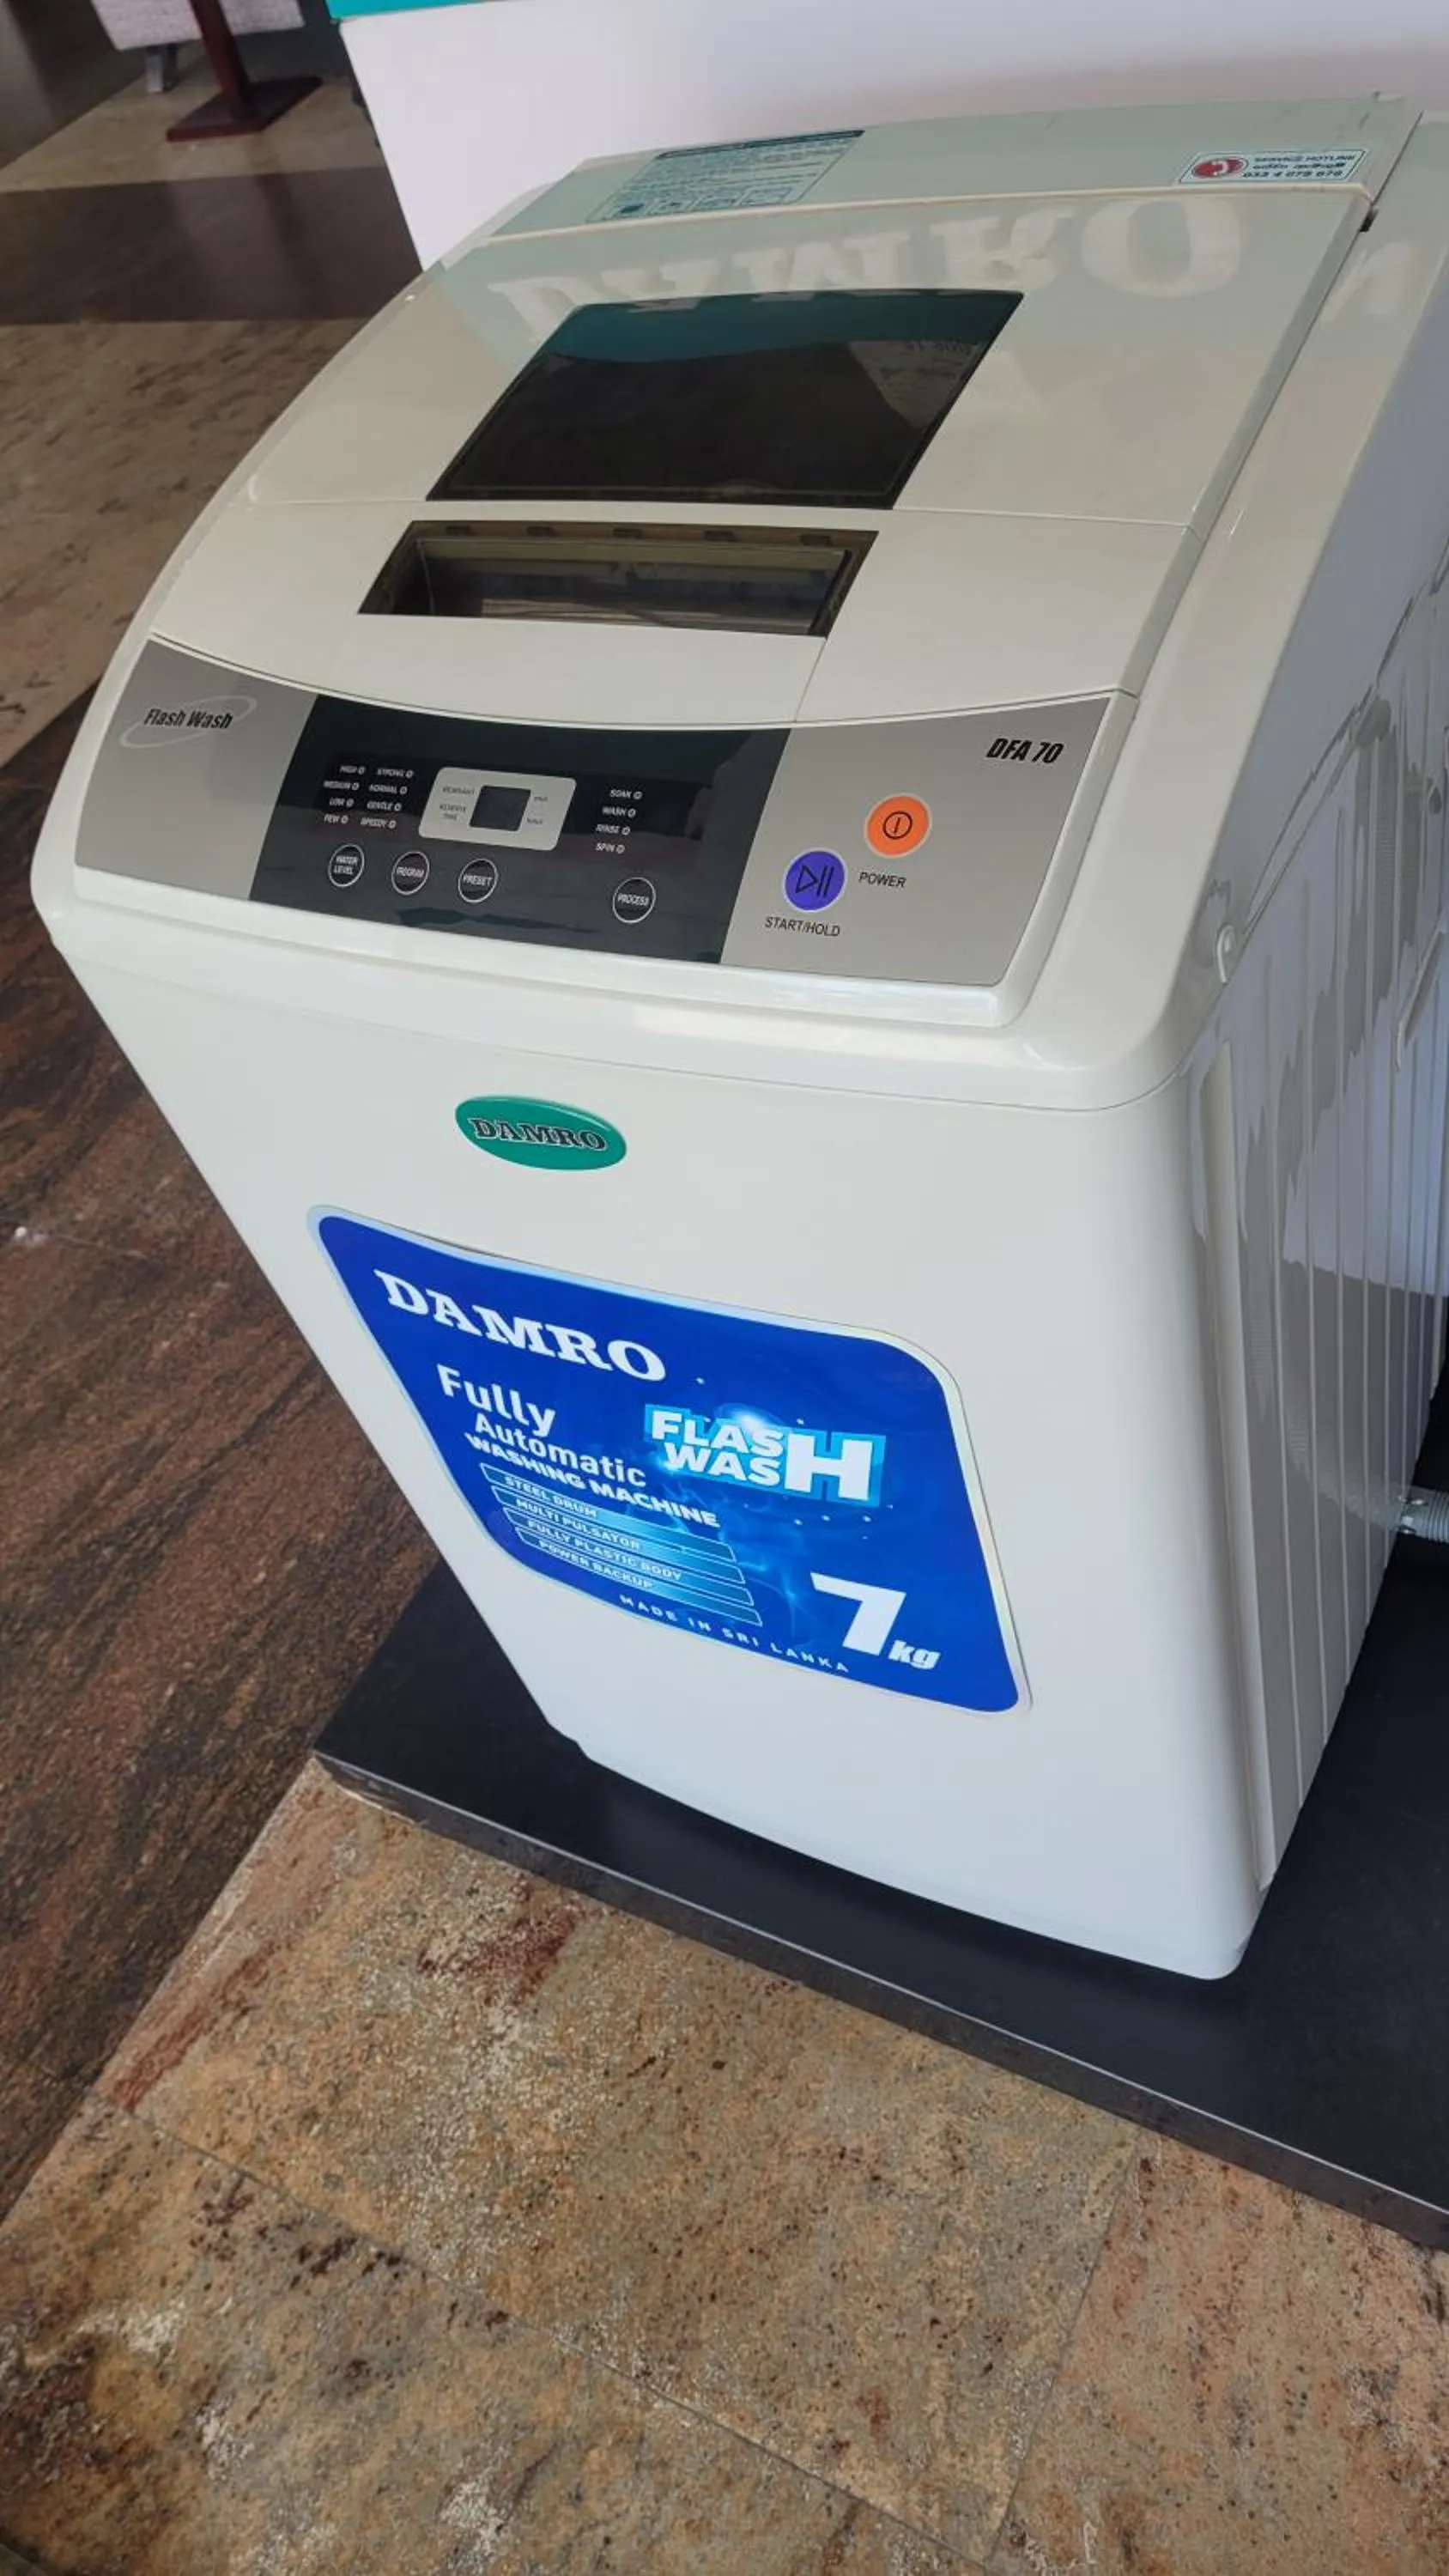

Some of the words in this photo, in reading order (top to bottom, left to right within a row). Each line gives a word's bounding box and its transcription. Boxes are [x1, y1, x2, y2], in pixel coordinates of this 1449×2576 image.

[143, 708, 186, 727] Flash
[186, 710, 234, 729] Wash
[985, 738, 1032, 762] DFA
[1032, 742, 1065, 764] 70
[463, 874, 494, 887] PRESET
[858, 872, 907, 889] POWER
[764, 916, 841, 937] START/HOLD
[468, 1118, 607, 1151] DAMRO
[373, 1268, 667, 1382] DAMRO
[436, 1363, 557, 1438] Fully
[474, 1412, 647, 1488] Automatic
[464, 1432, 587, 1491] WASHING
[588, 1479, 721, 1528] MACHINE
[504, 1475, 551, 1501] STEEL
[553, 1492, 597, 1518] DRUM
[515, 1498, 560, 1526] MULTI
[562, 1512, 641, 1551] PULSATOR
[527, 1518, 573, 1543] FULLY
[573, 1537, 639, 1568] PLASTIC
[640, 1560, 683, 1582] BODY
[538, 1539, 591, 1568] POWER
[592, 1559, 655, 1589] BACKUP
[619, 1594, 679, 1622] MADE
[688, 1617, 712, 1632] IN
[722, 1627, 760, 1648] SRI
[770, 1642, 849, 1674] LANKA
[809, 1571, 907, 1657] 7
[888, 1639, 942, 1670] kg
